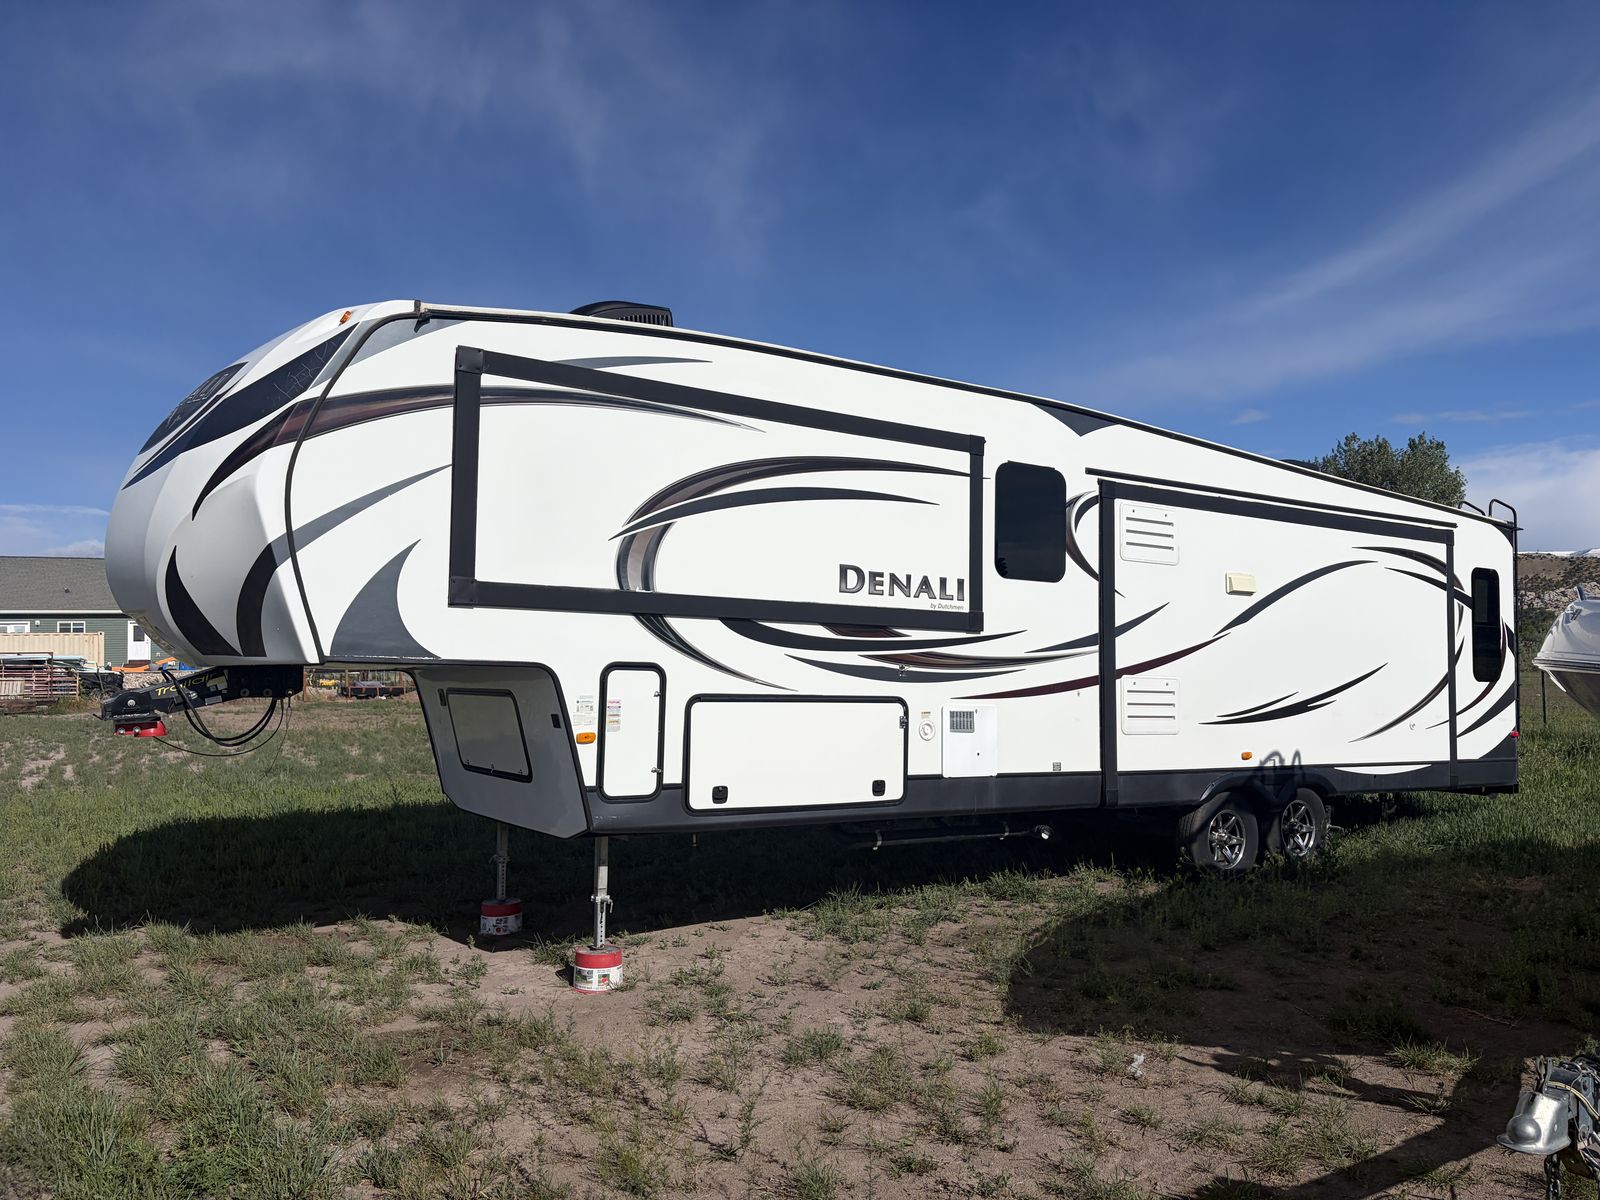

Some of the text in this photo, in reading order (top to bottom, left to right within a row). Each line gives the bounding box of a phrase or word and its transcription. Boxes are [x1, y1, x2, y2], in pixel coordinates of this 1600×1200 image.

[838, 563, 965, 601] DENALI
[930, 602, 965, 610] by Dutchmen
